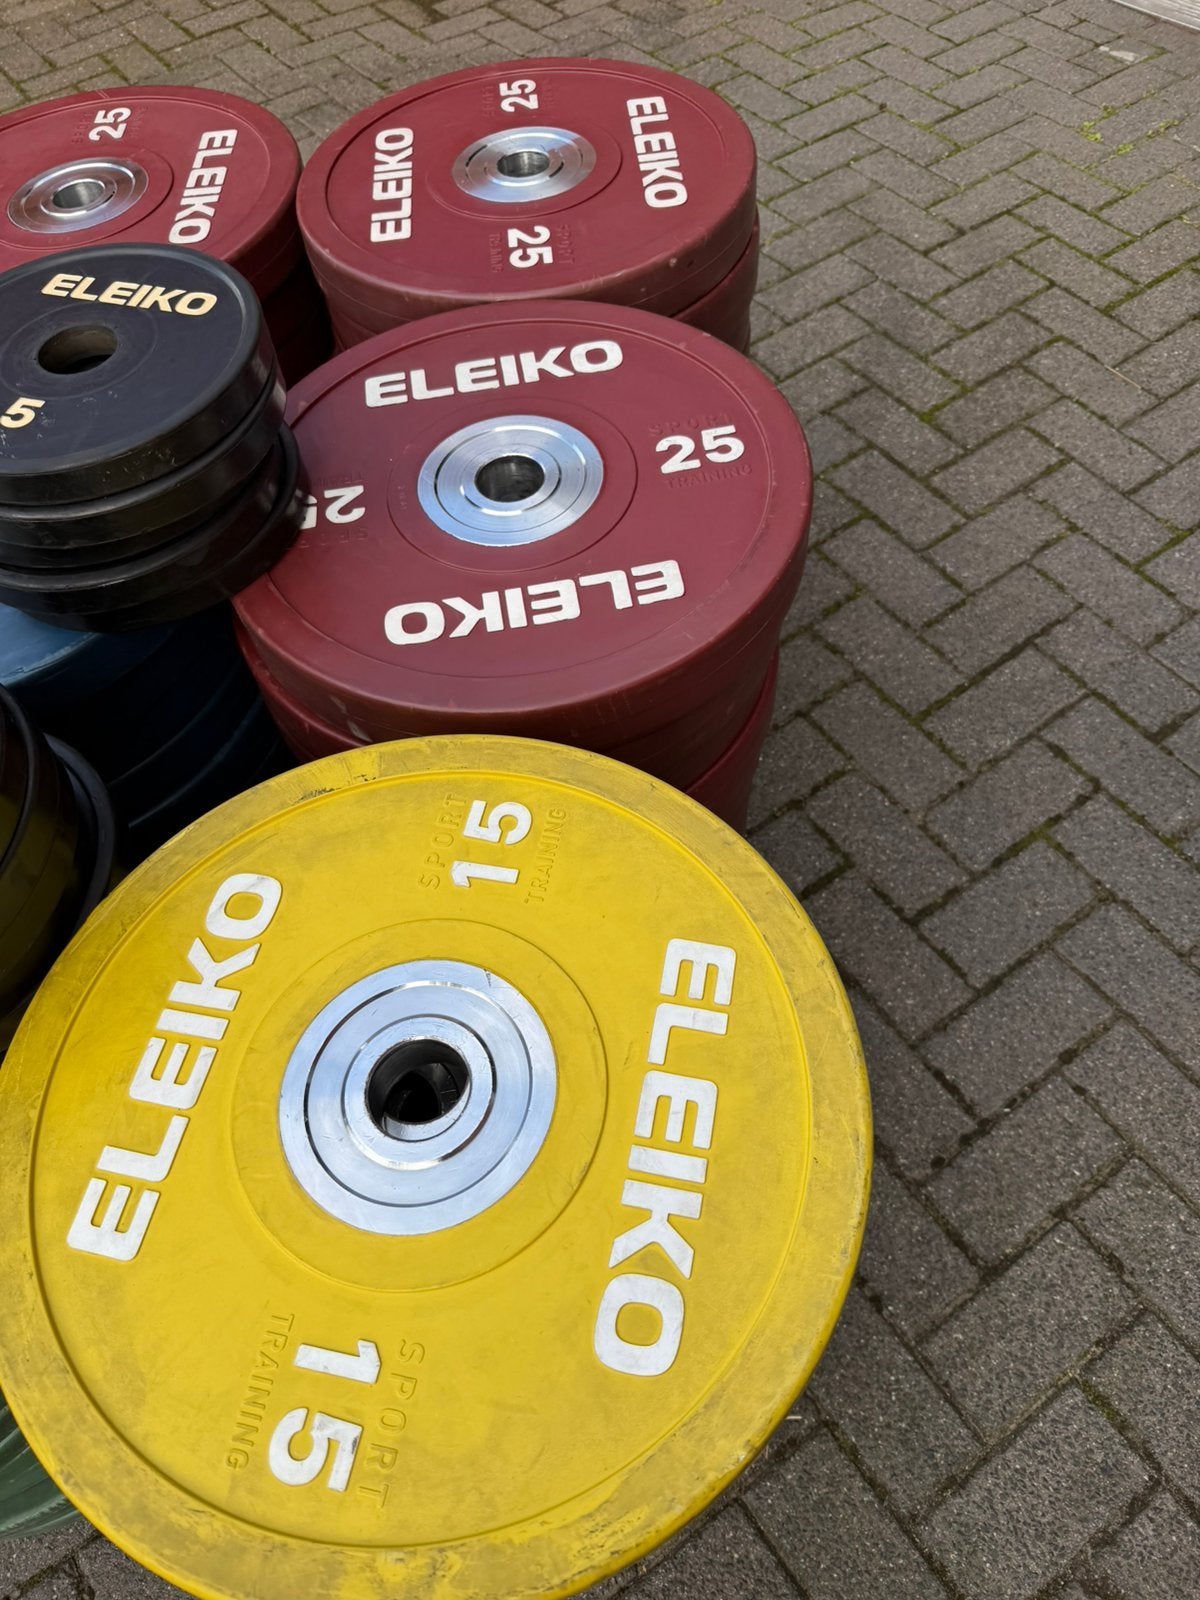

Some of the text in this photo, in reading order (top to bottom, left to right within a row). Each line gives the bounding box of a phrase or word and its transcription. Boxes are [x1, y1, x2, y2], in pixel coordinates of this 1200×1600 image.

[89, 107, 131, 141] 25
[500, 79, 539, 113] 25
[168, 128, 238, 244] ELEIKO
[370, 127, 414, 243] ELEIKO
[626, 95, 688, 209] ELEIKO
[41, 273, 218, 316] ELEIKO
[507, 225, 554, 269] 25
[364, 339, 624, 408] ELEIKO
[655, 424, 745, 474] 25
[383, 559, 685, 646] ELEIKO
[418, 793, 467, 890] SPORT
[450, 799, 532, 888] 15
[524, 807, 568, 905] TRAINING
[65, 873, 284, 1262] ELEIKO
[593, 938, 737, 1377] ELEIKO
[226, 1312, 295, 1471] TRAINING
[268, 1337, 381, 1493] 15
[356, 1338, 426, 1509] SPORT
